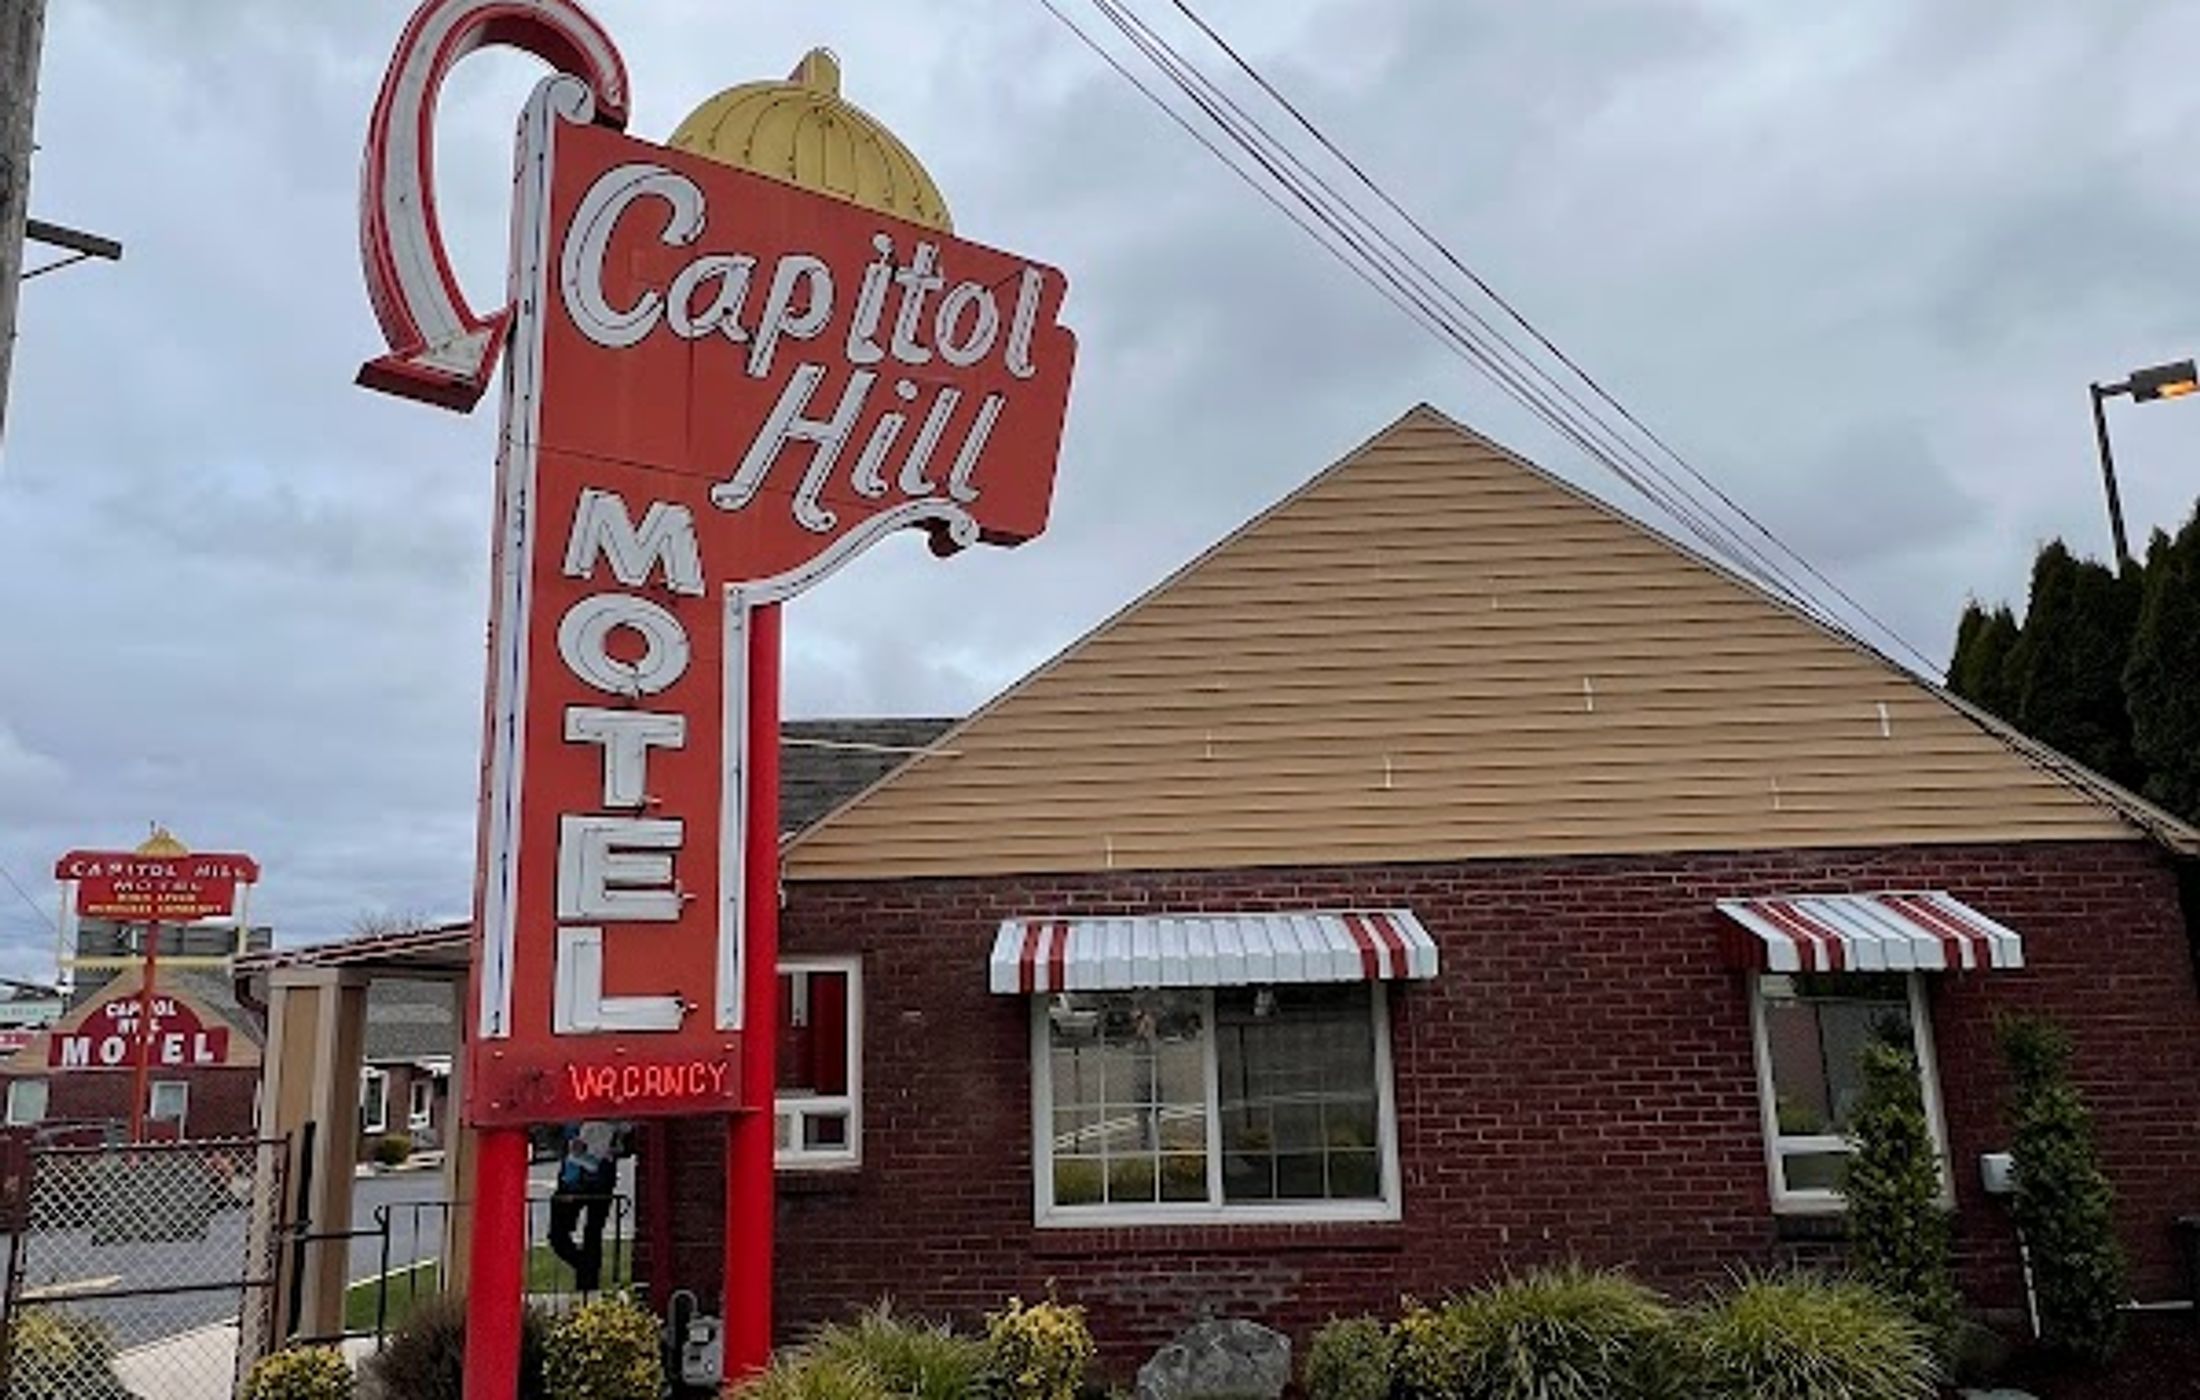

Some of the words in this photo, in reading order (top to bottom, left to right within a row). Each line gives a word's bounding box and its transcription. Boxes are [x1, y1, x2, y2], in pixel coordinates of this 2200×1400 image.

[561, 163, 1043, 379] Capitol
[711, 362, 1005, 532] Hill
[553, 487, 705, 1035] MOTEL
[70, 861, 177, 877] CAPITOL
[195, 864, 247, 878] HILL
[106, 1000, 178, 1018] CAPOL
[117, 1018, 162, 1034] HIL
[61, 1032, 214, 1067] MOEL
[568, 1062, 728, 1101] VACANCY
